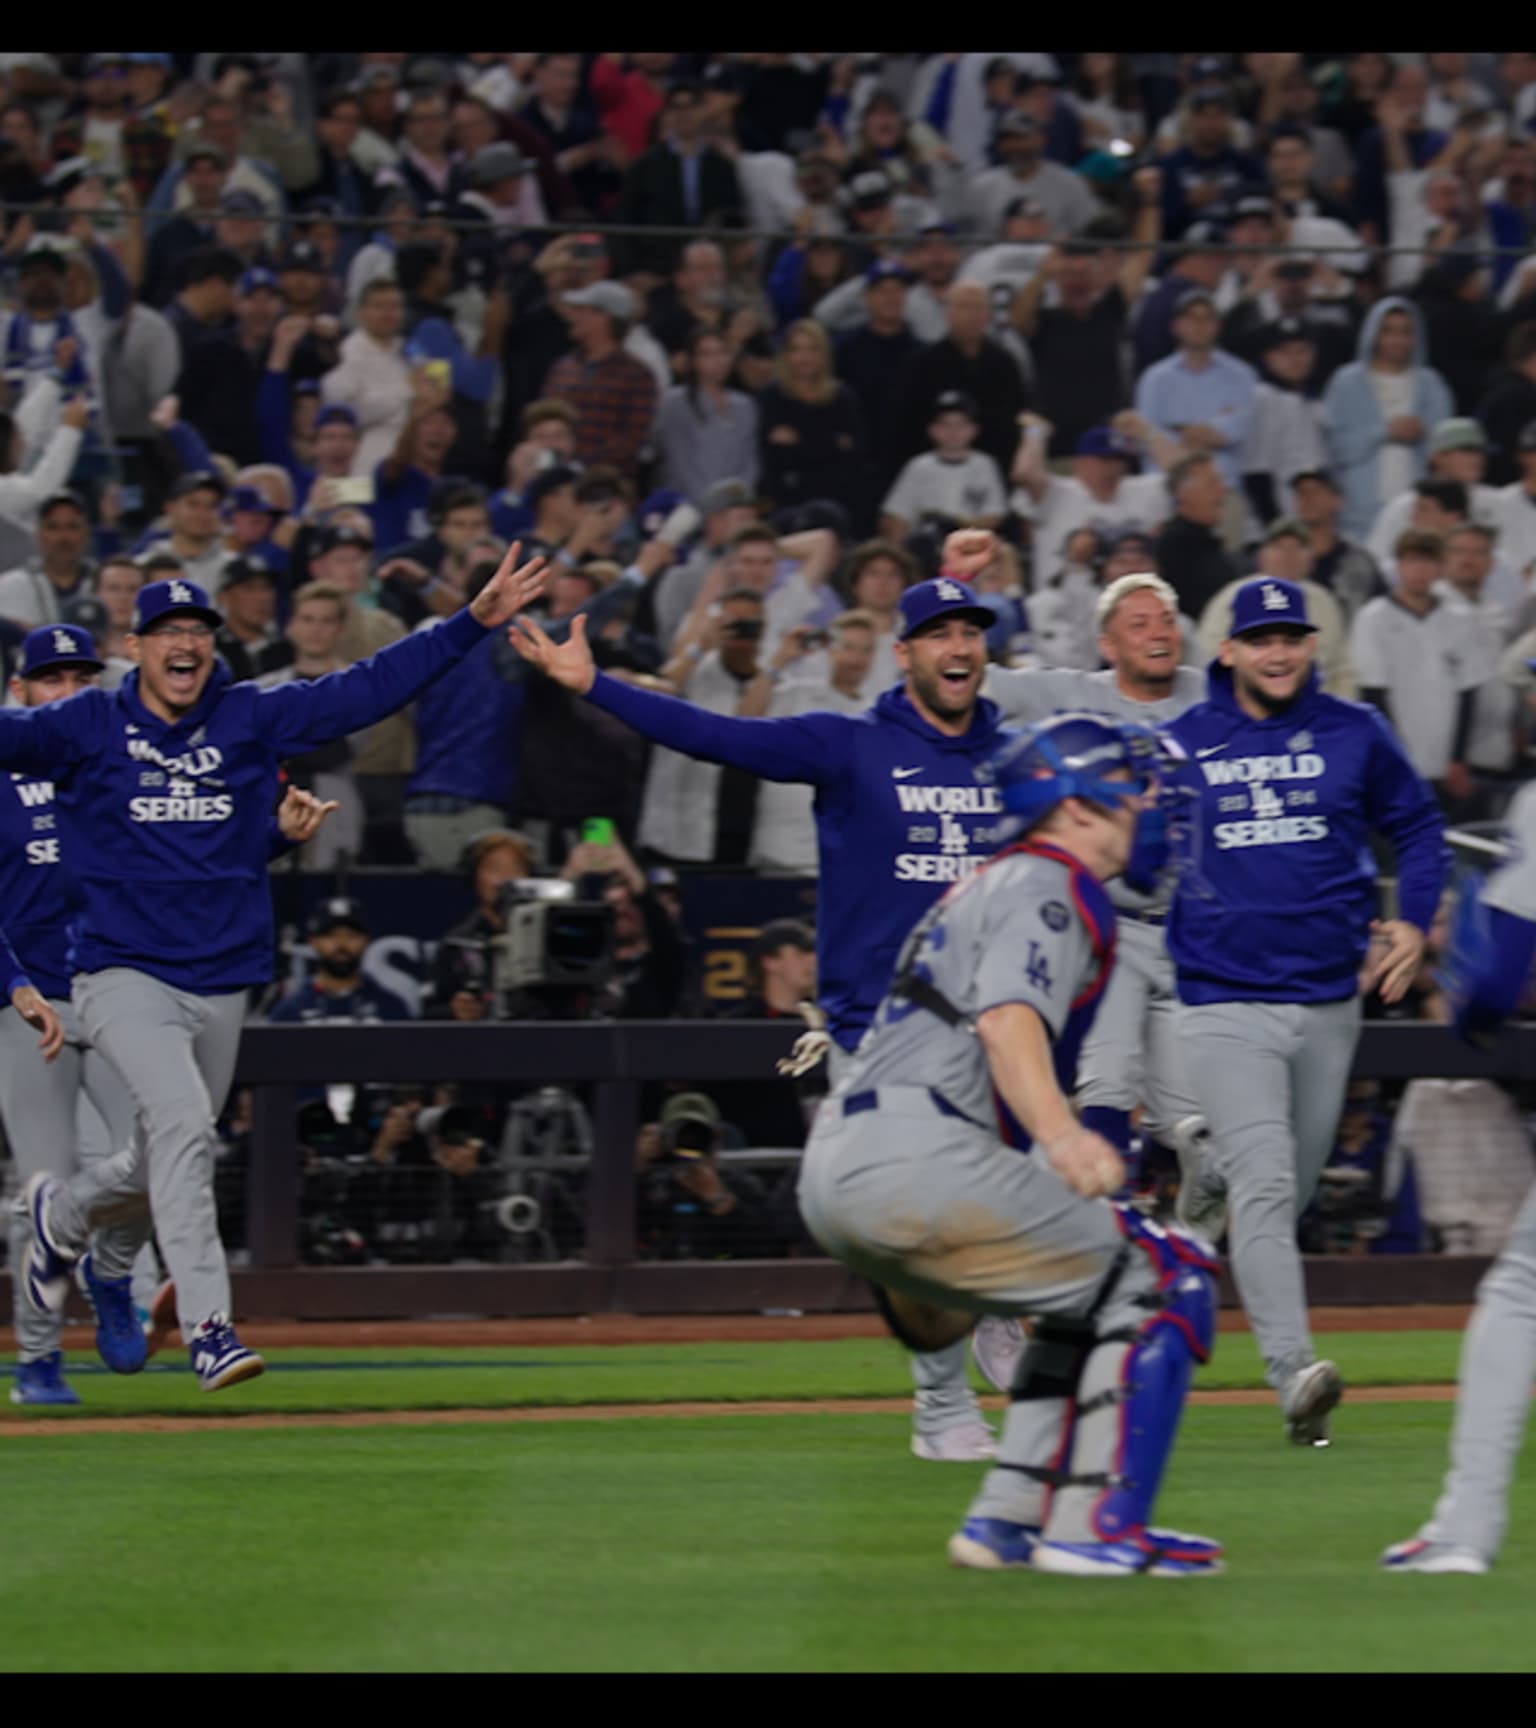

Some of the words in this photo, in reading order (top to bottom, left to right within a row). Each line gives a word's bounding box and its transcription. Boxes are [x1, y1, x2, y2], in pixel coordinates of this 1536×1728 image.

[1261, 584, 1291, 611] LA
[1201, 752, 1326, 786] WORLD
[129, 794, 233, 822] SERIES
[939, 813, 969, 854] LA
[1213, 815, 1330, 849] SERIES
[1023, 938, 1054, 998] LA
